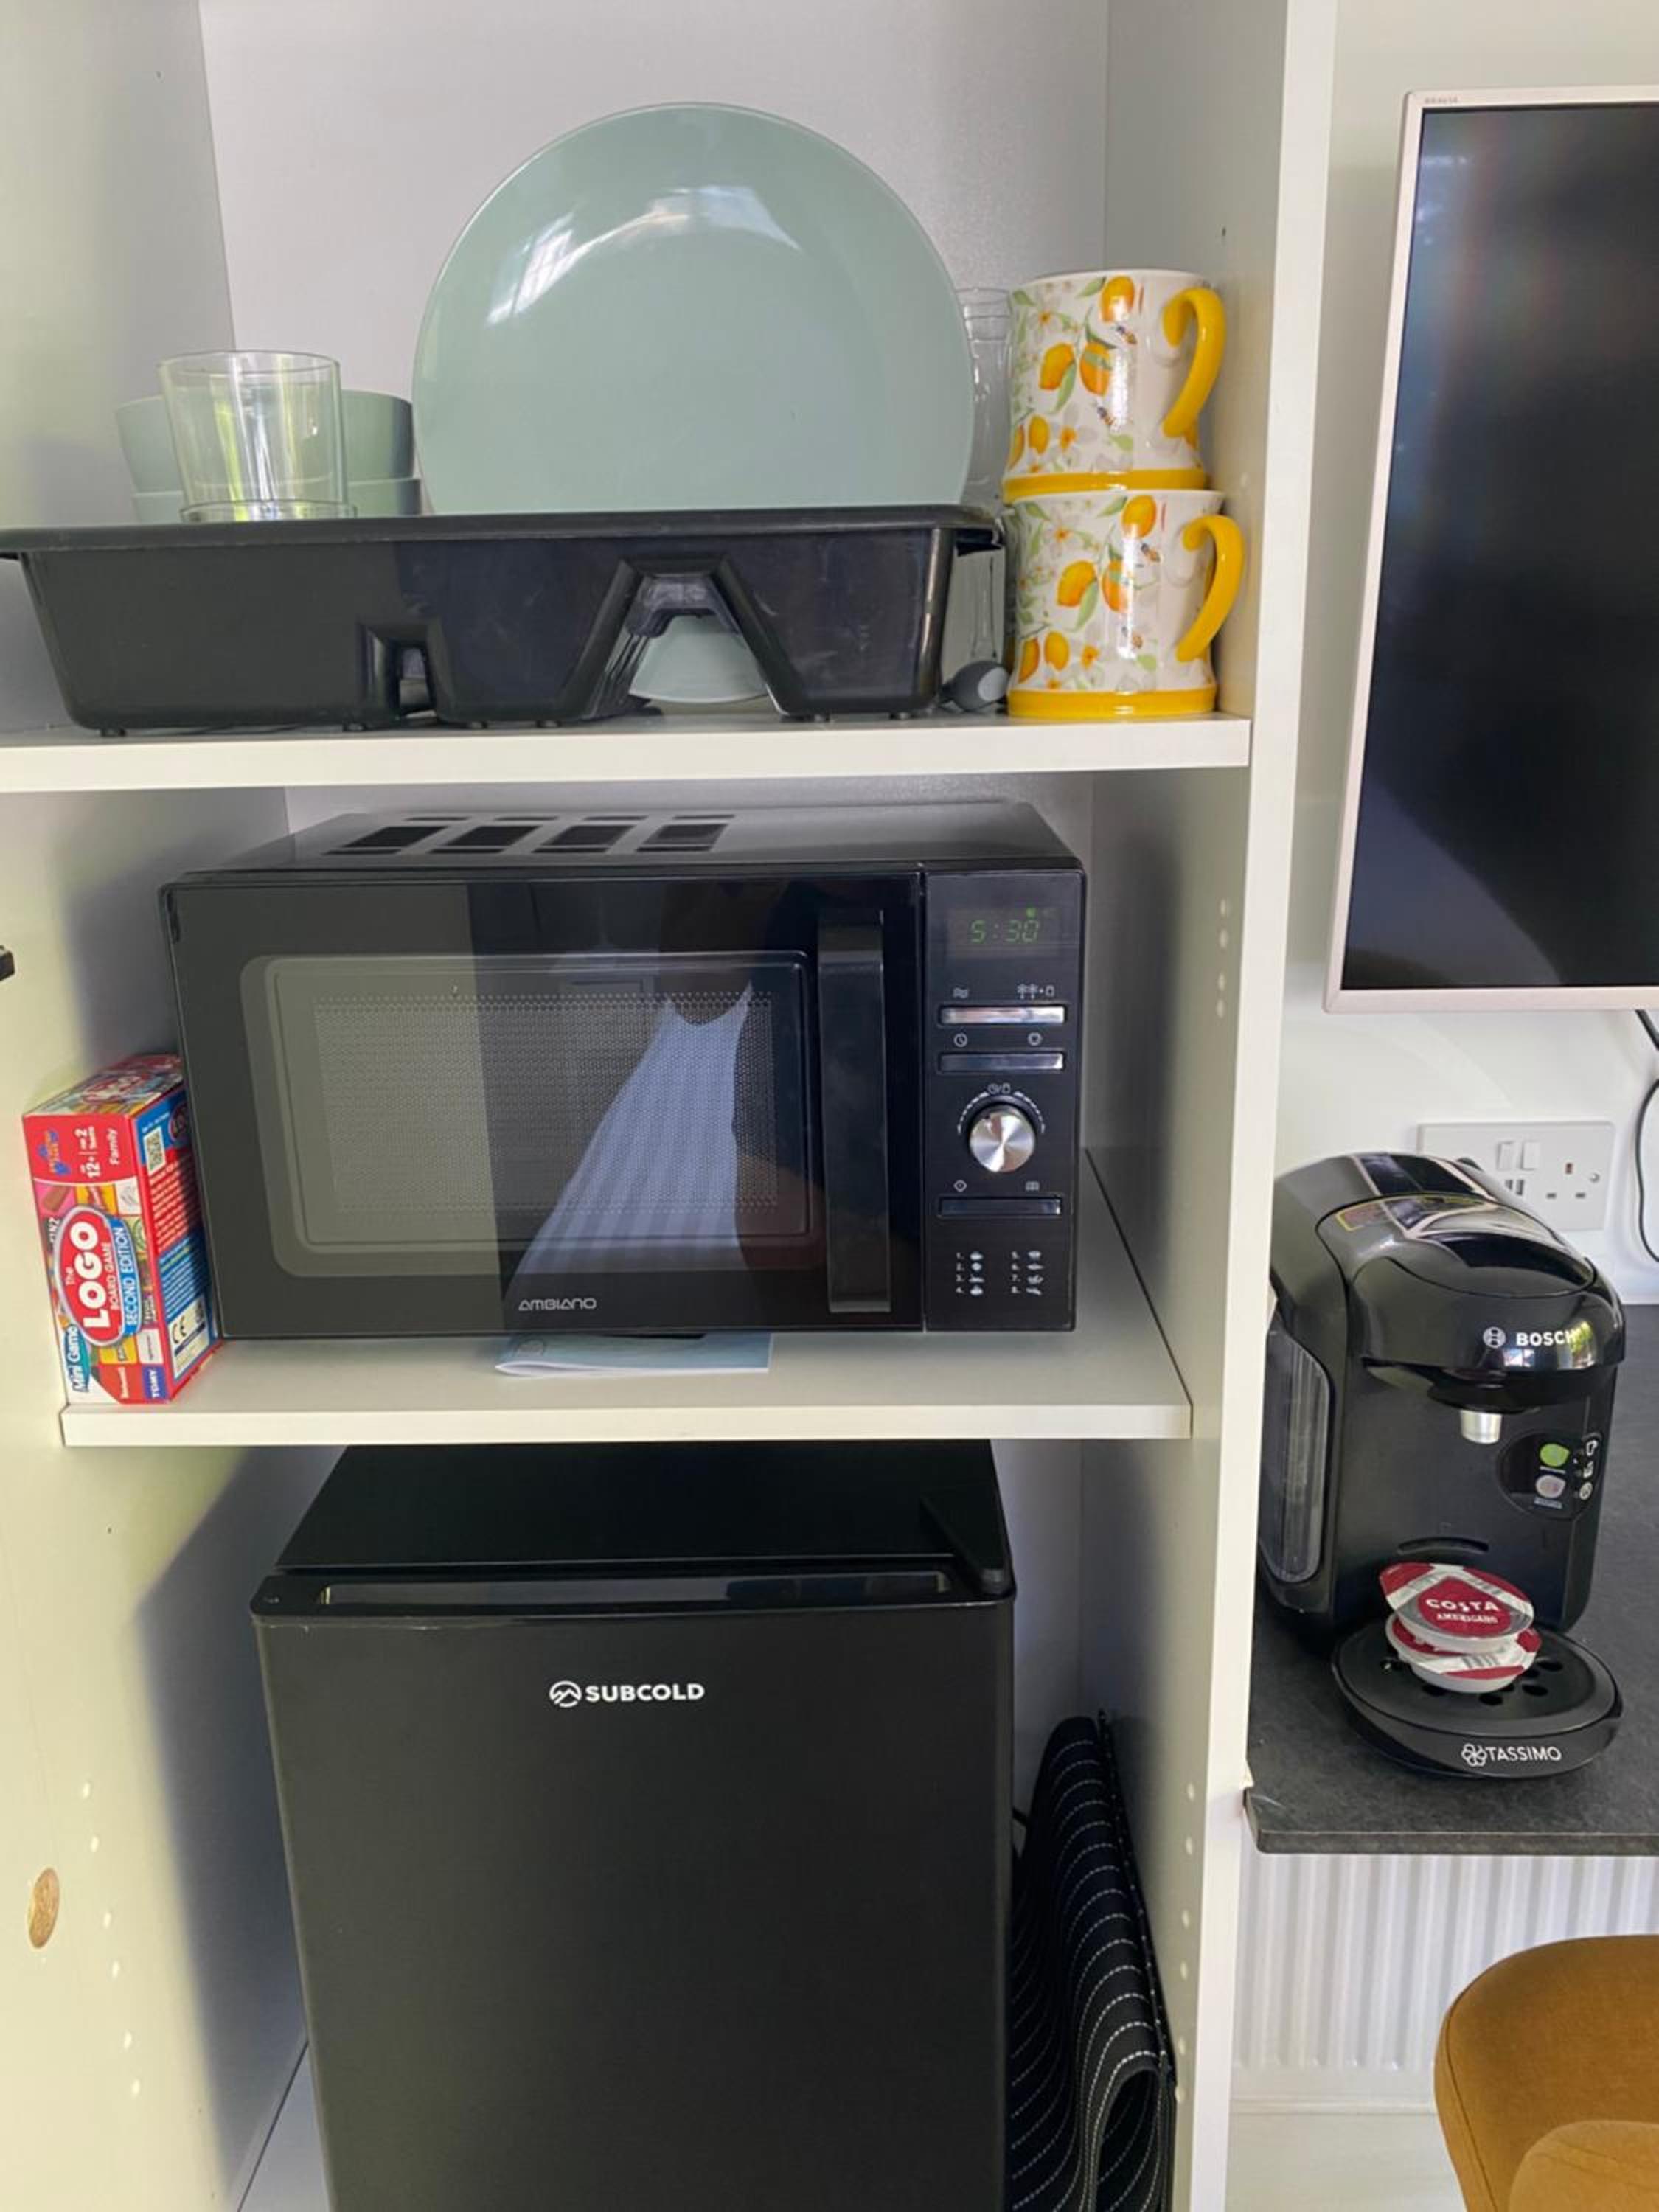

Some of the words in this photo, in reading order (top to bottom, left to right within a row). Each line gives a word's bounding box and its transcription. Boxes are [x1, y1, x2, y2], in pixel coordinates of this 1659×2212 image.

[970, 919, 1040, 943] 5:30
[106, 1127, 119, 1165] Family
[101, 1242, 114, 1273] GAME
[112, 1226, 134, 1273] EDITION
[65, 1266, 76, 1286] The
[70, 1221, 111, 1328] LOGO
[105, 1274, 119, 1310] BOARD
[122, 1276, 139, 1325] SECOND
[518, 1298, 597, 1311] AMBIANO
[67, 1325, 80, 1362] Game
[1515, 1329, 1580, 1347] BOSCH
[68, 1365, 88, 1392] Mini
[149, 1368, 160, 1398] TOMY
[1425, 1599, 1501, 1613] COSTA
[585, 1683, 705, 1703] SUBCOLD
[1485, 1746, 1562, 1761] TASSIMO
